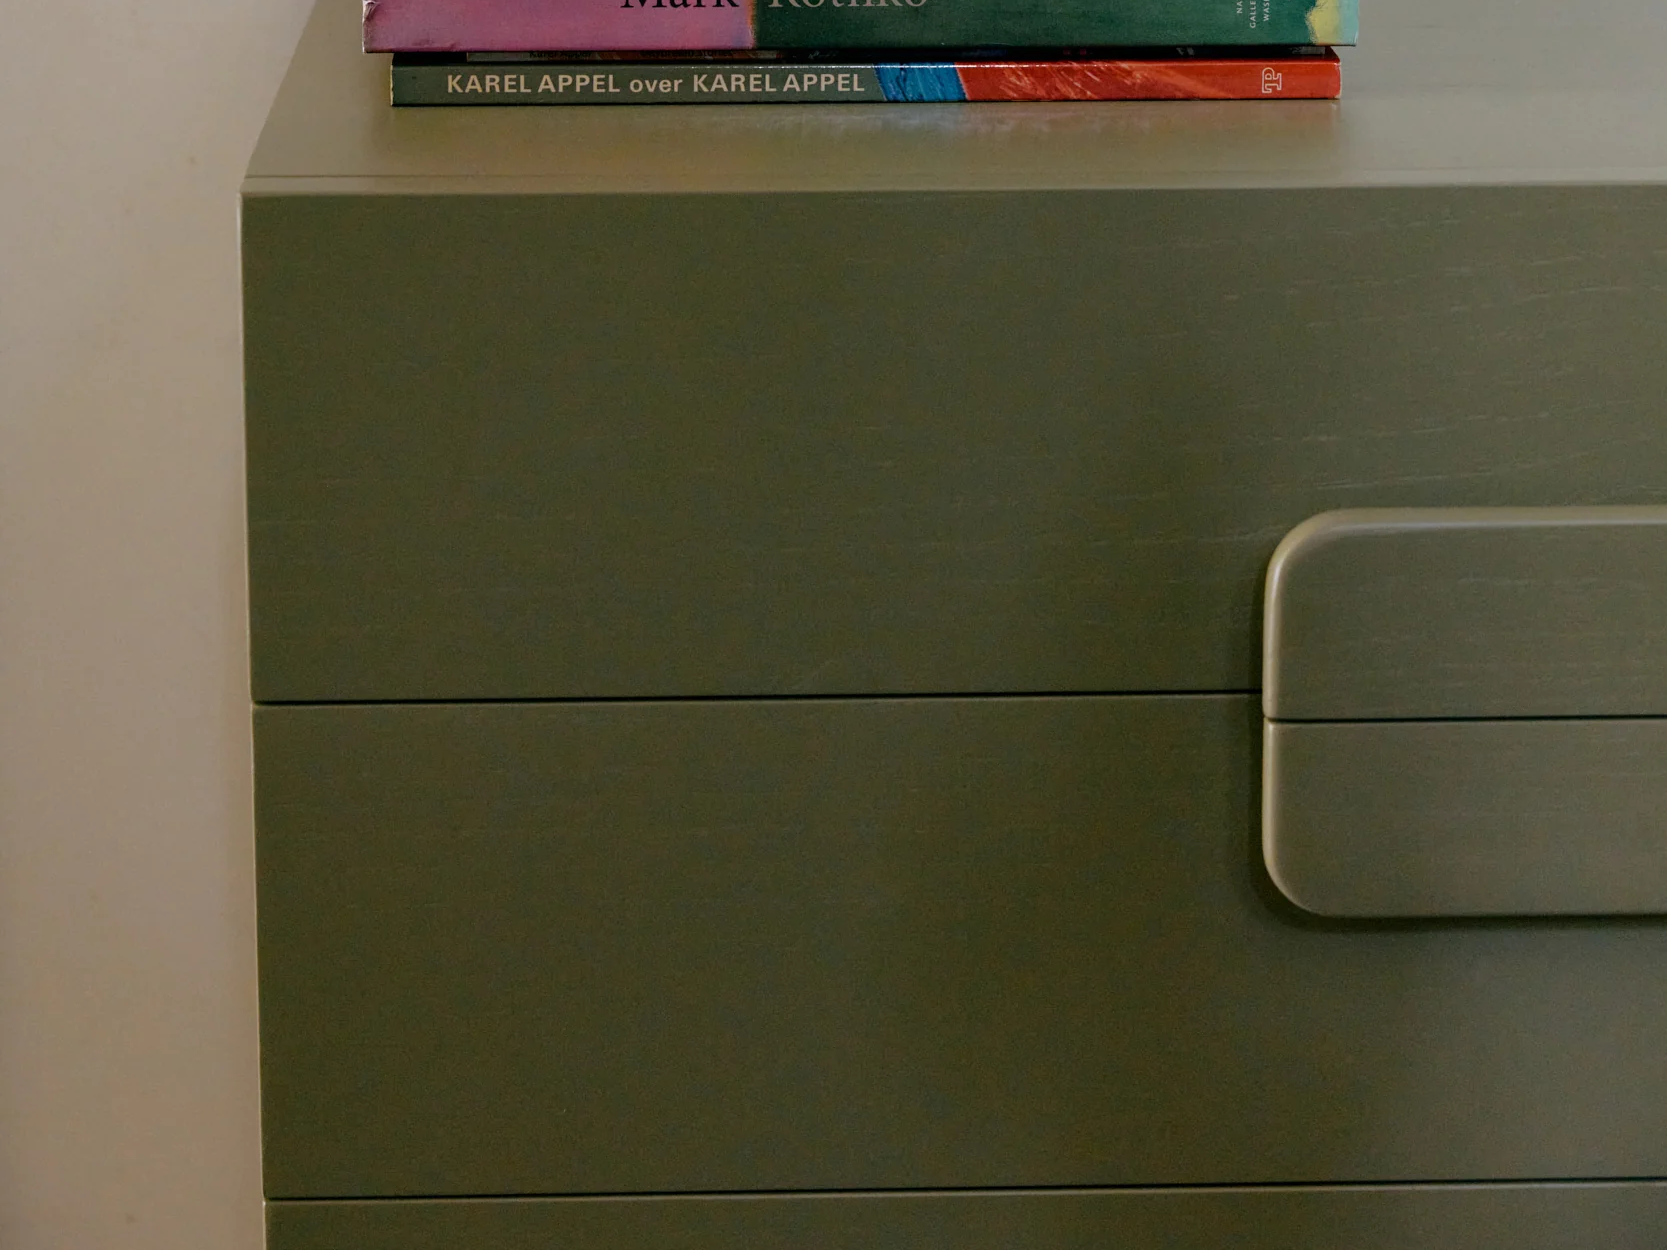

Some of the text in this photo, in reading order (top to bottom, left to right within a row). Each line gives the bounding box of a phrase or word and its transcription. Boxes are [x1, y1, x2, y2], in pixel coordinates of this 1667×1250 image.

[447, 74, 865, 93] KAREL APPEL over KAREL APPEL
